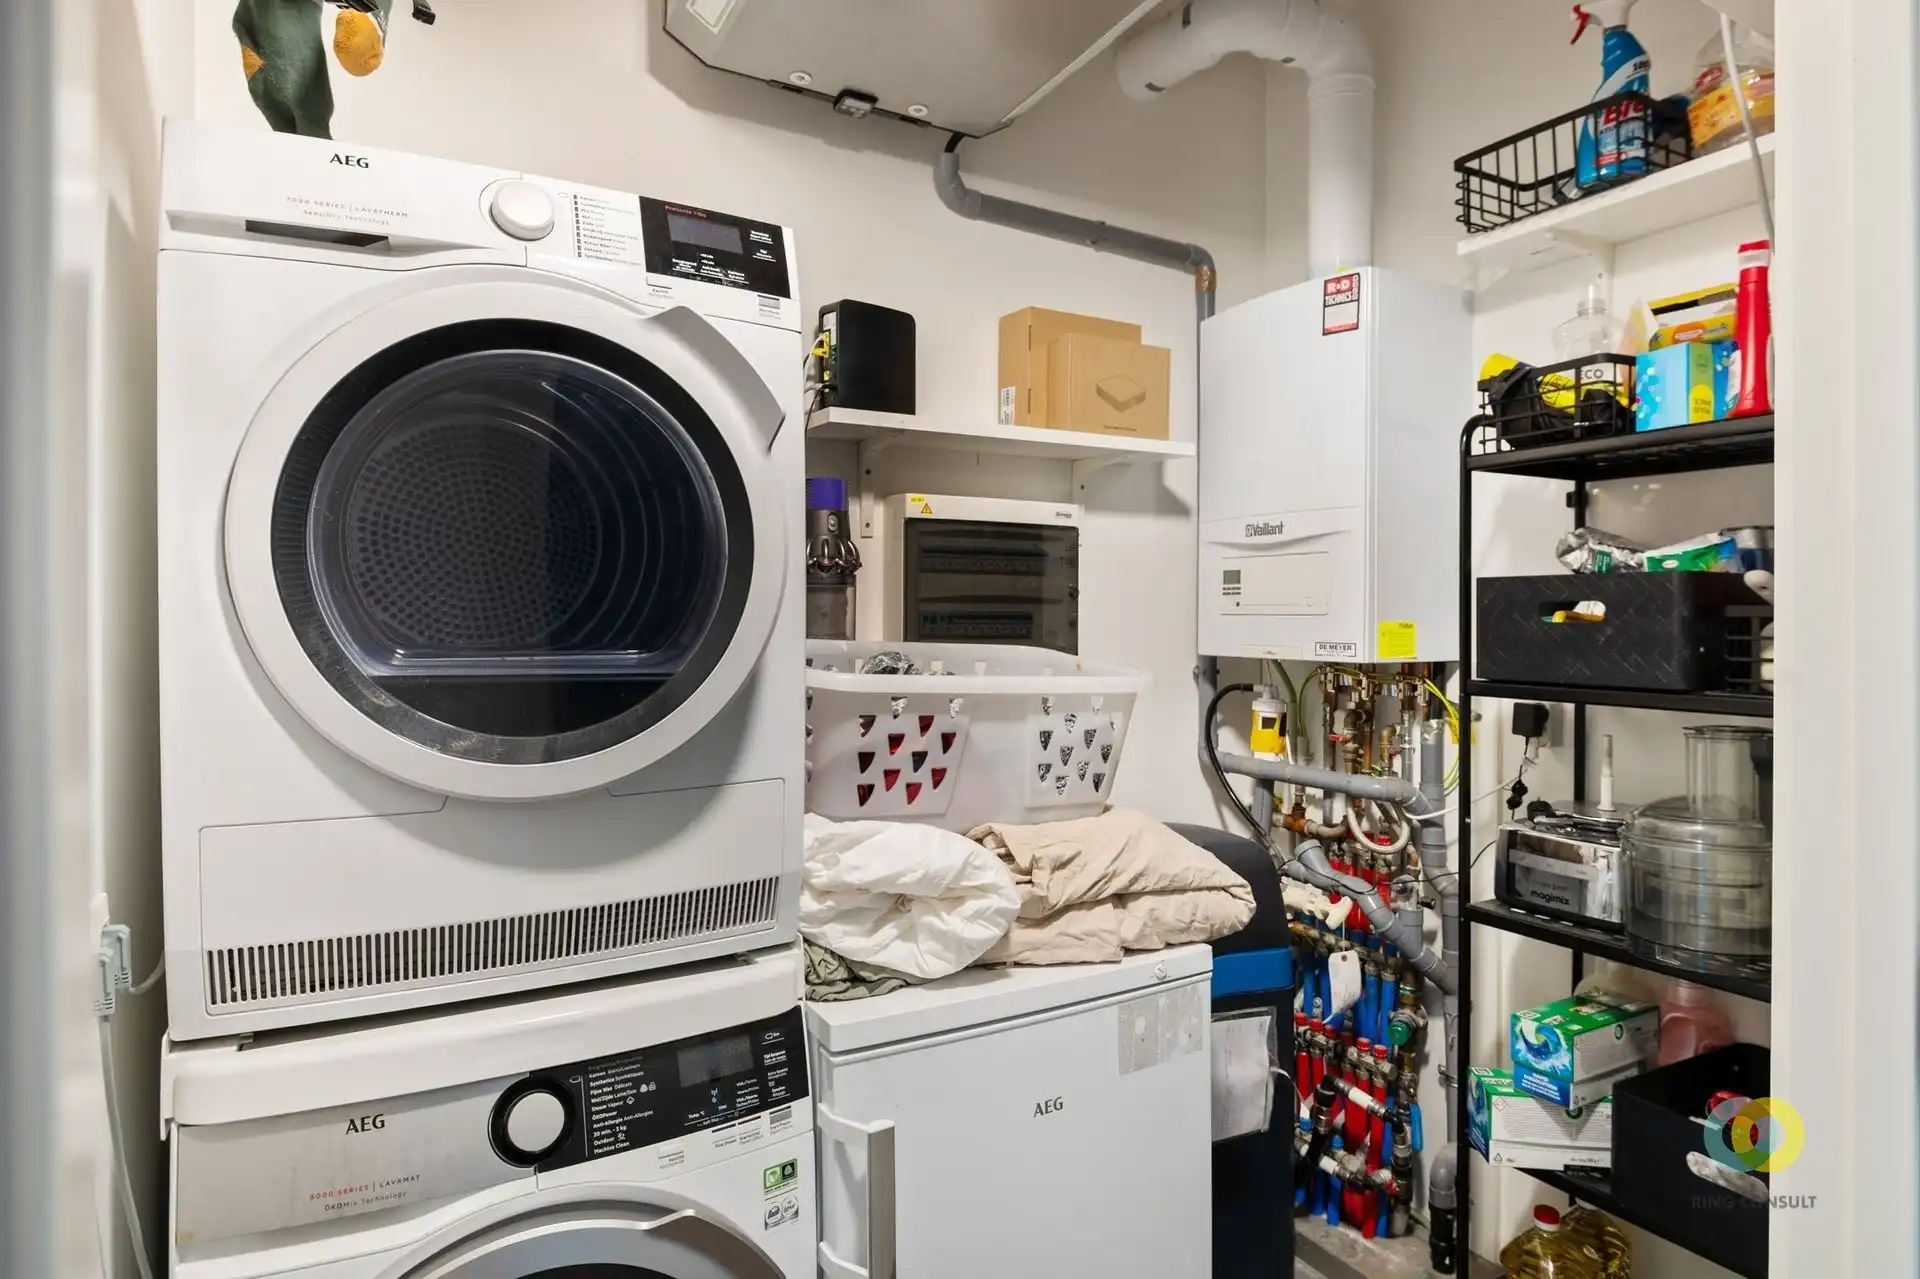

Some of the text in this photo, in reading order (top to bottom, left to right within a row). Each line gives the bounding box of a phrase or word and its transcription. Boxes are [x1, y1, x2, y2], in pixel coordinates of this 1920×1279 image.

[330, 153, 370, 169] AEG
[313, 200, 346, 210] SERIES
[355, 206, 409, 218] LAVATHERM
[1254, 520, 1285, 537] Vaillant
[1530, 890, 1571, 906] magimix
[1033, 1096, 1064, 1118] AEG
[345, 1113, 386, 1135] AEG
[337, 1184, 369, 1196] SERIES
[379, 1174, 421, 1189] LAVAMAT
[361, 1191, 408, 1205] Technology
